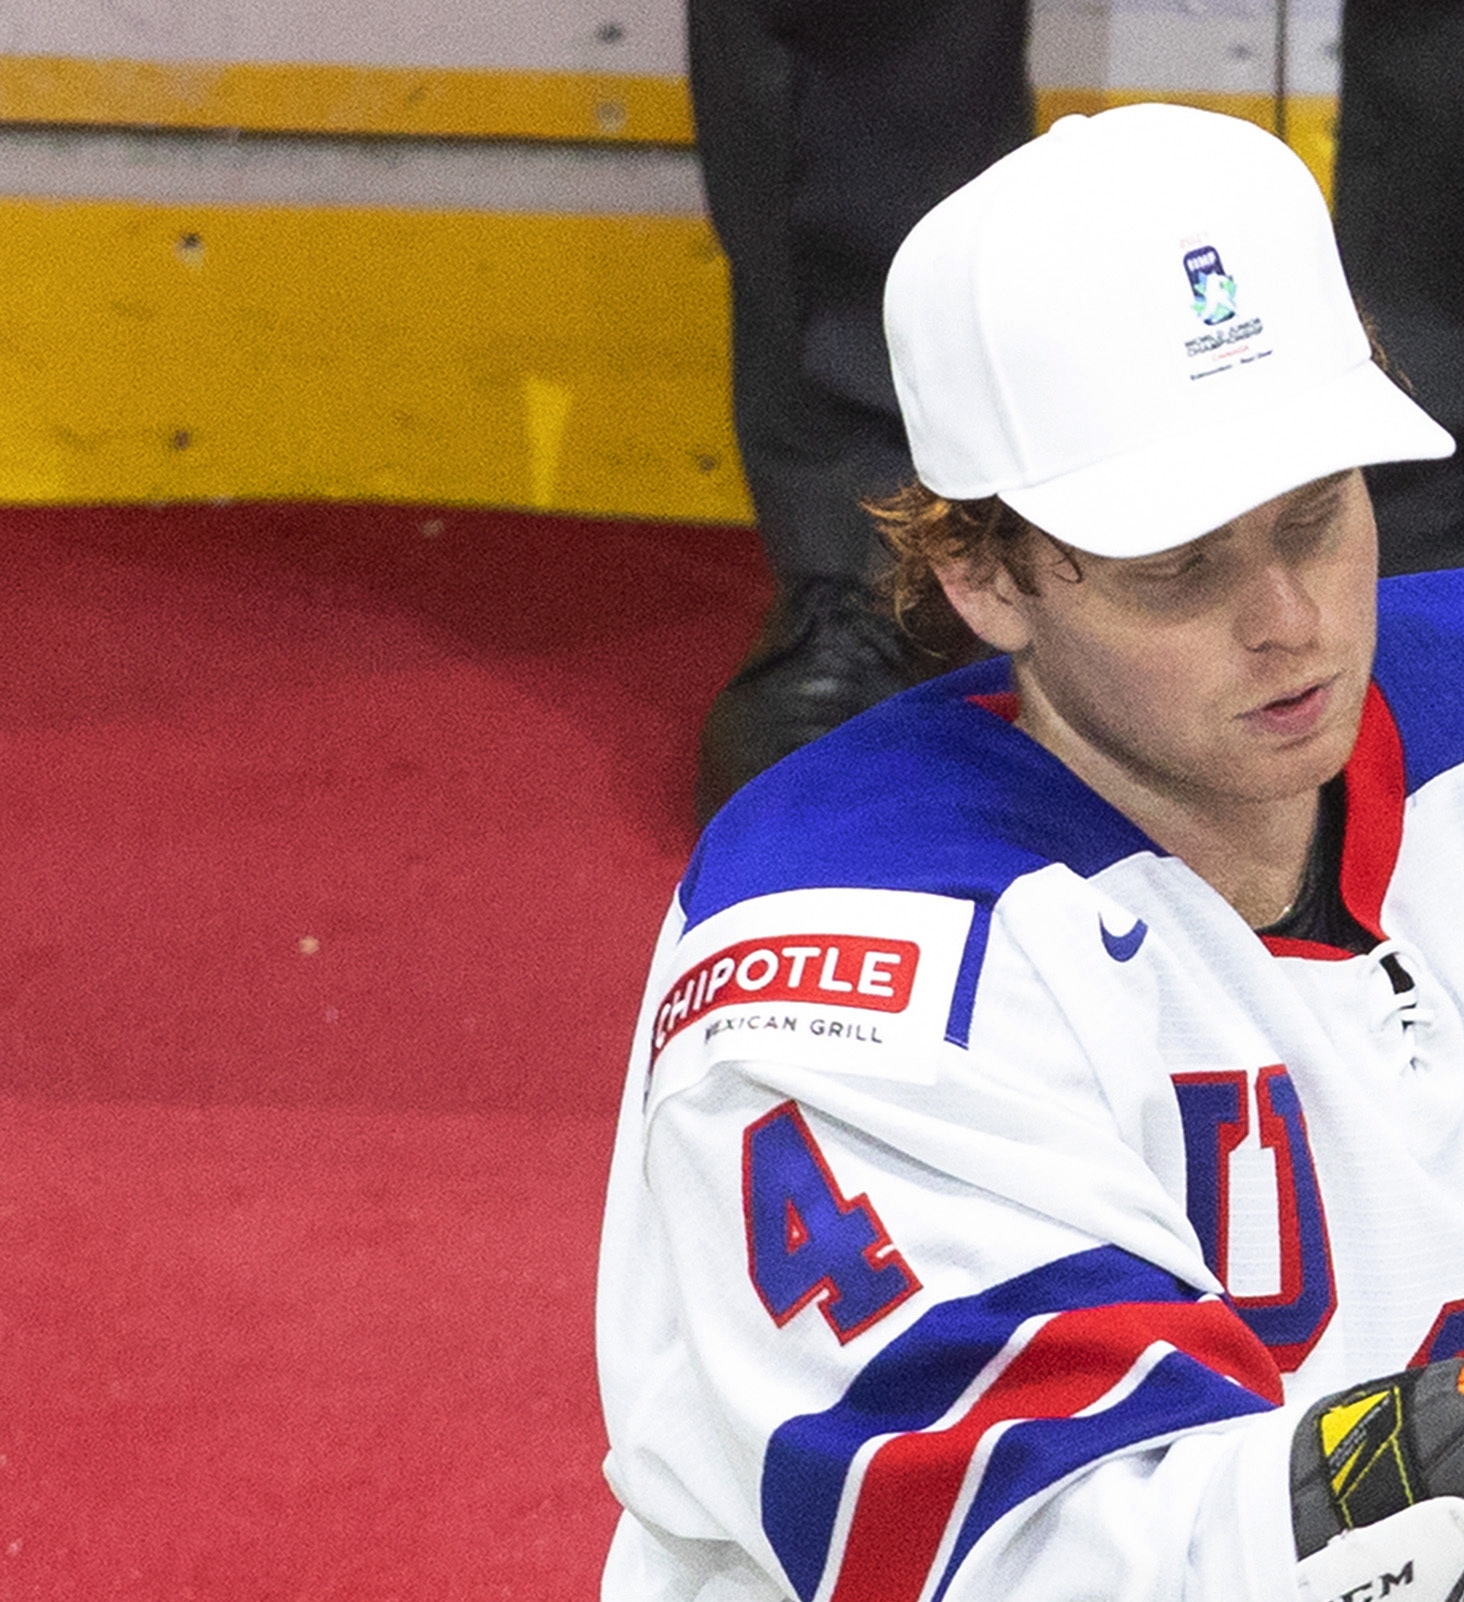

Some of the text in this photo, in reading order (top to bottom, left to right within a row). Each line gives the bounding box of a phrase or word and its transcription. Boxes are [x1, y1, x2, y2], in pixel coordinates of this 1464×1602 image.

[654, 946, 901, 1050] CHIPOTLE
[809, 1018, 884, 1044] GRILL
[742, 1099, 924, 1347] 4
